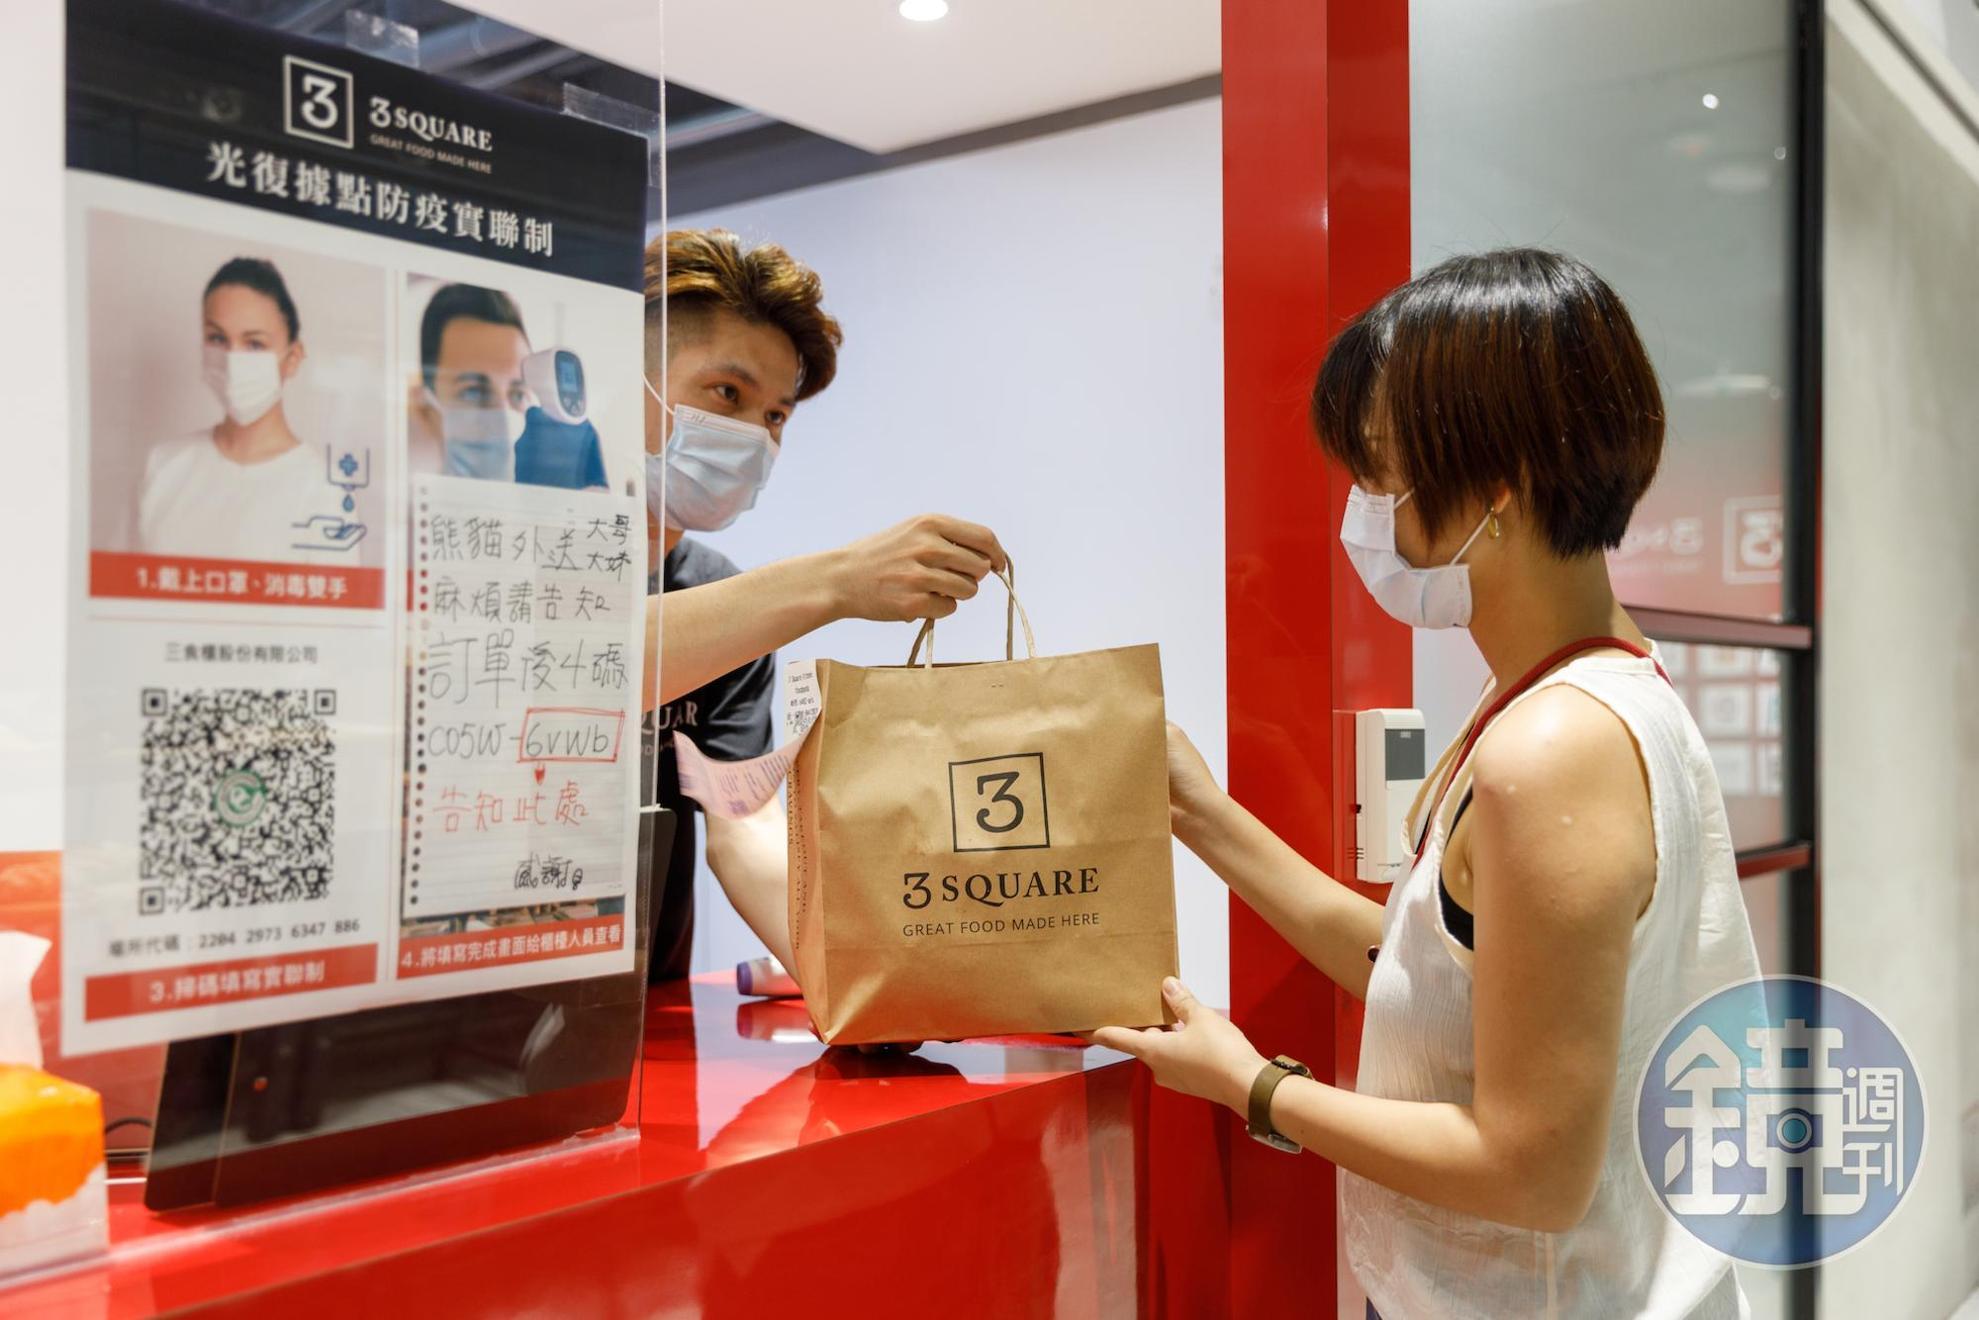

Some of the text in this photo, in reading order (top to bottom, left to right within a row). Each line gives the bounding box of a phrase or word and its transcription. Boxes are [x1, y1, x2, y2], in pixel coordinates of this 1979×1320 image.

[301, 75, 338, 129] 3
[370, 133, 493, 175] GREAT FOOD MADE HERE
[205, 141, 553, 257] 光復據點防疫實聯制
[433, 575, 612, 624] 麻煩請告知
[432, 780, 588, 832] 告知此處
[976, 771, 1024, 833] 3
[942, 867, 1099, 908] SQUARE
[903, 912, 1100, 937] GREAT FOOD MADE HERE
